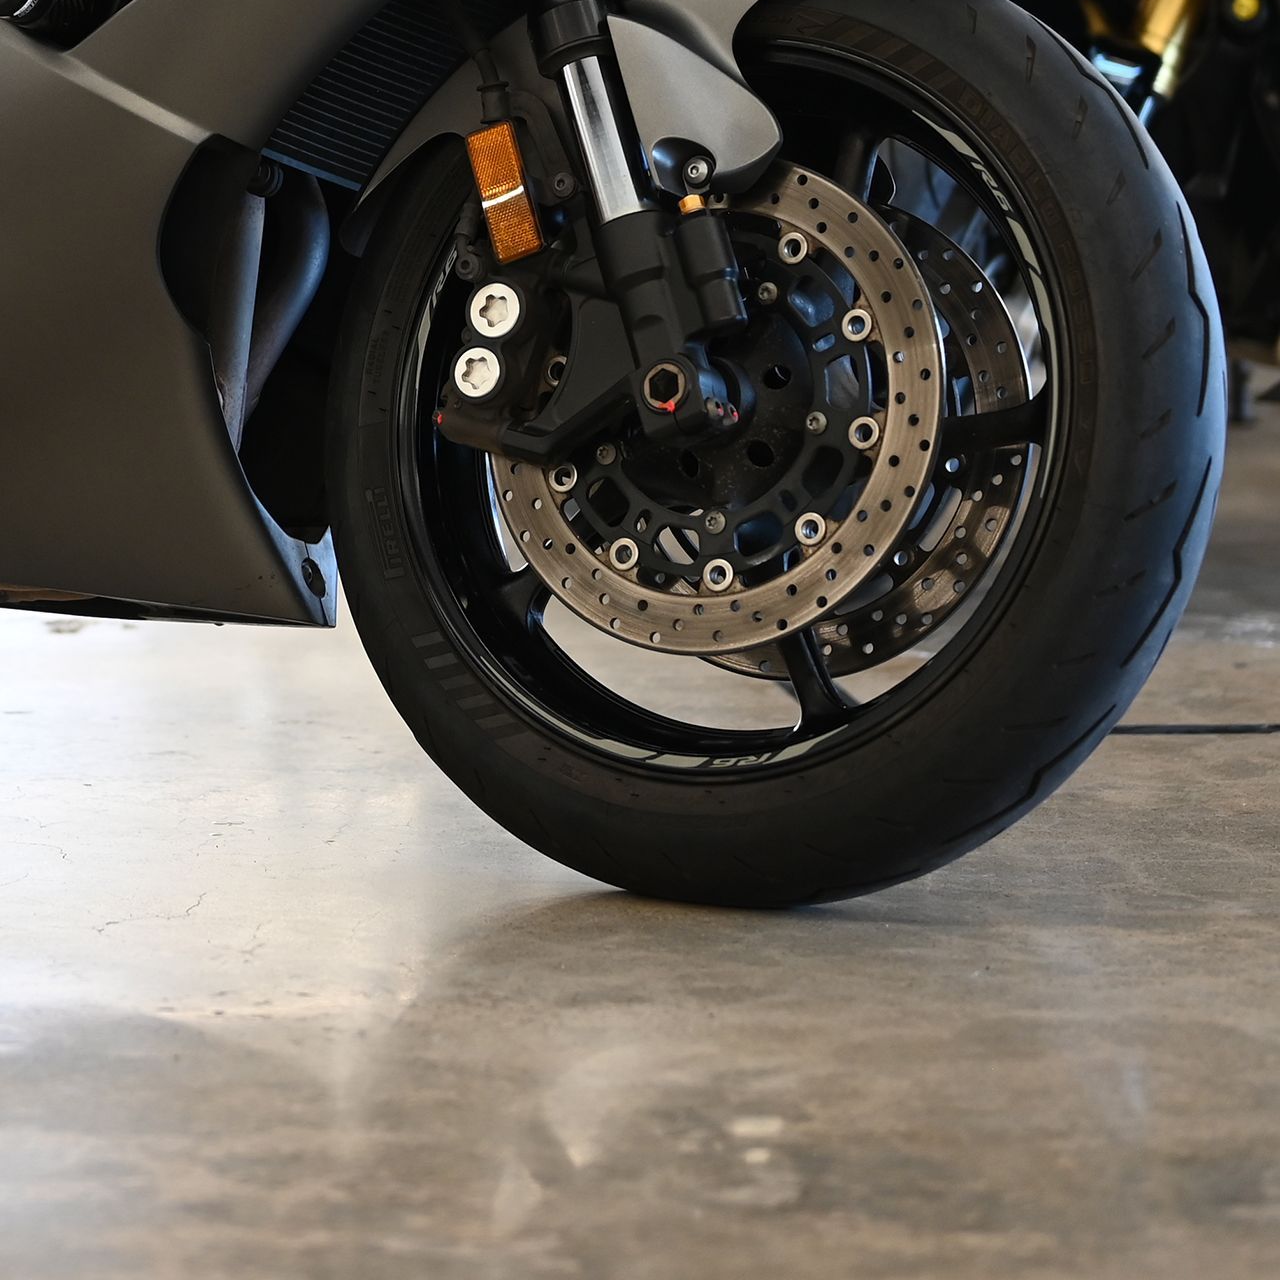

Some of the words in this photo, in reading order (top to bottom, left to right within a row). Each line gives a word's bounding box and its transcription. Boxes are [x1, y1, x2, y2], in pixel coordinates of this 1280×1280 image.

[970, 161, 1014, 213] R6
[364, 487, 405, 580] PIRELLI
[709, 752, 772, 768] R6
